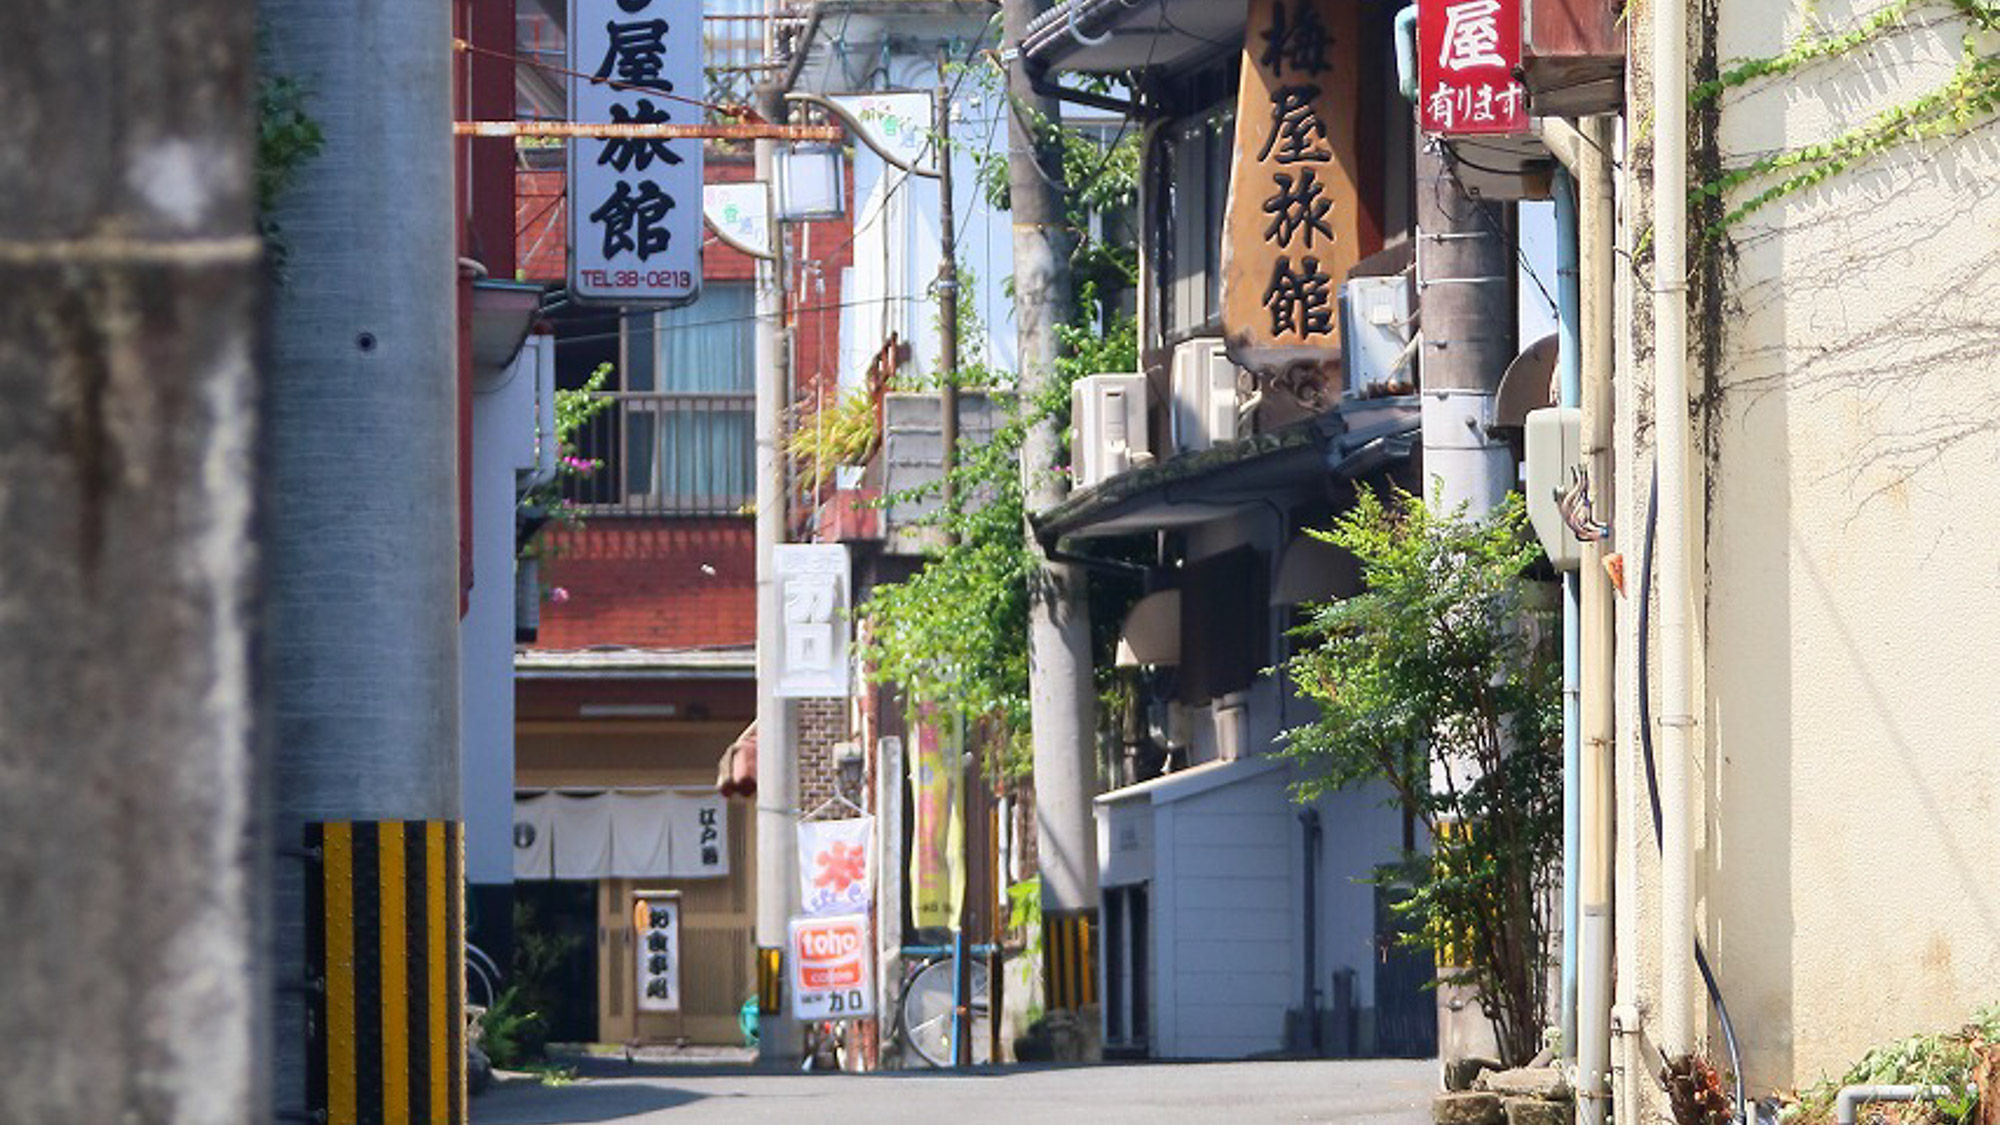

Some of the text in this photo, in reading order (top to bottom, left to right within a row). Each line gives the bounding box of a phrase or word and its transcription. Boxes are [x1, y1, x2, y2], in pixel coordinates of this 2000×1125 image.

[590, 0, 683, 262] 屋旅館
[1257, 2, 1336, 340] 梅屋旅館
[1426, 81, 1523, 129] 有ります
[802, 928, 857, 956] toho
